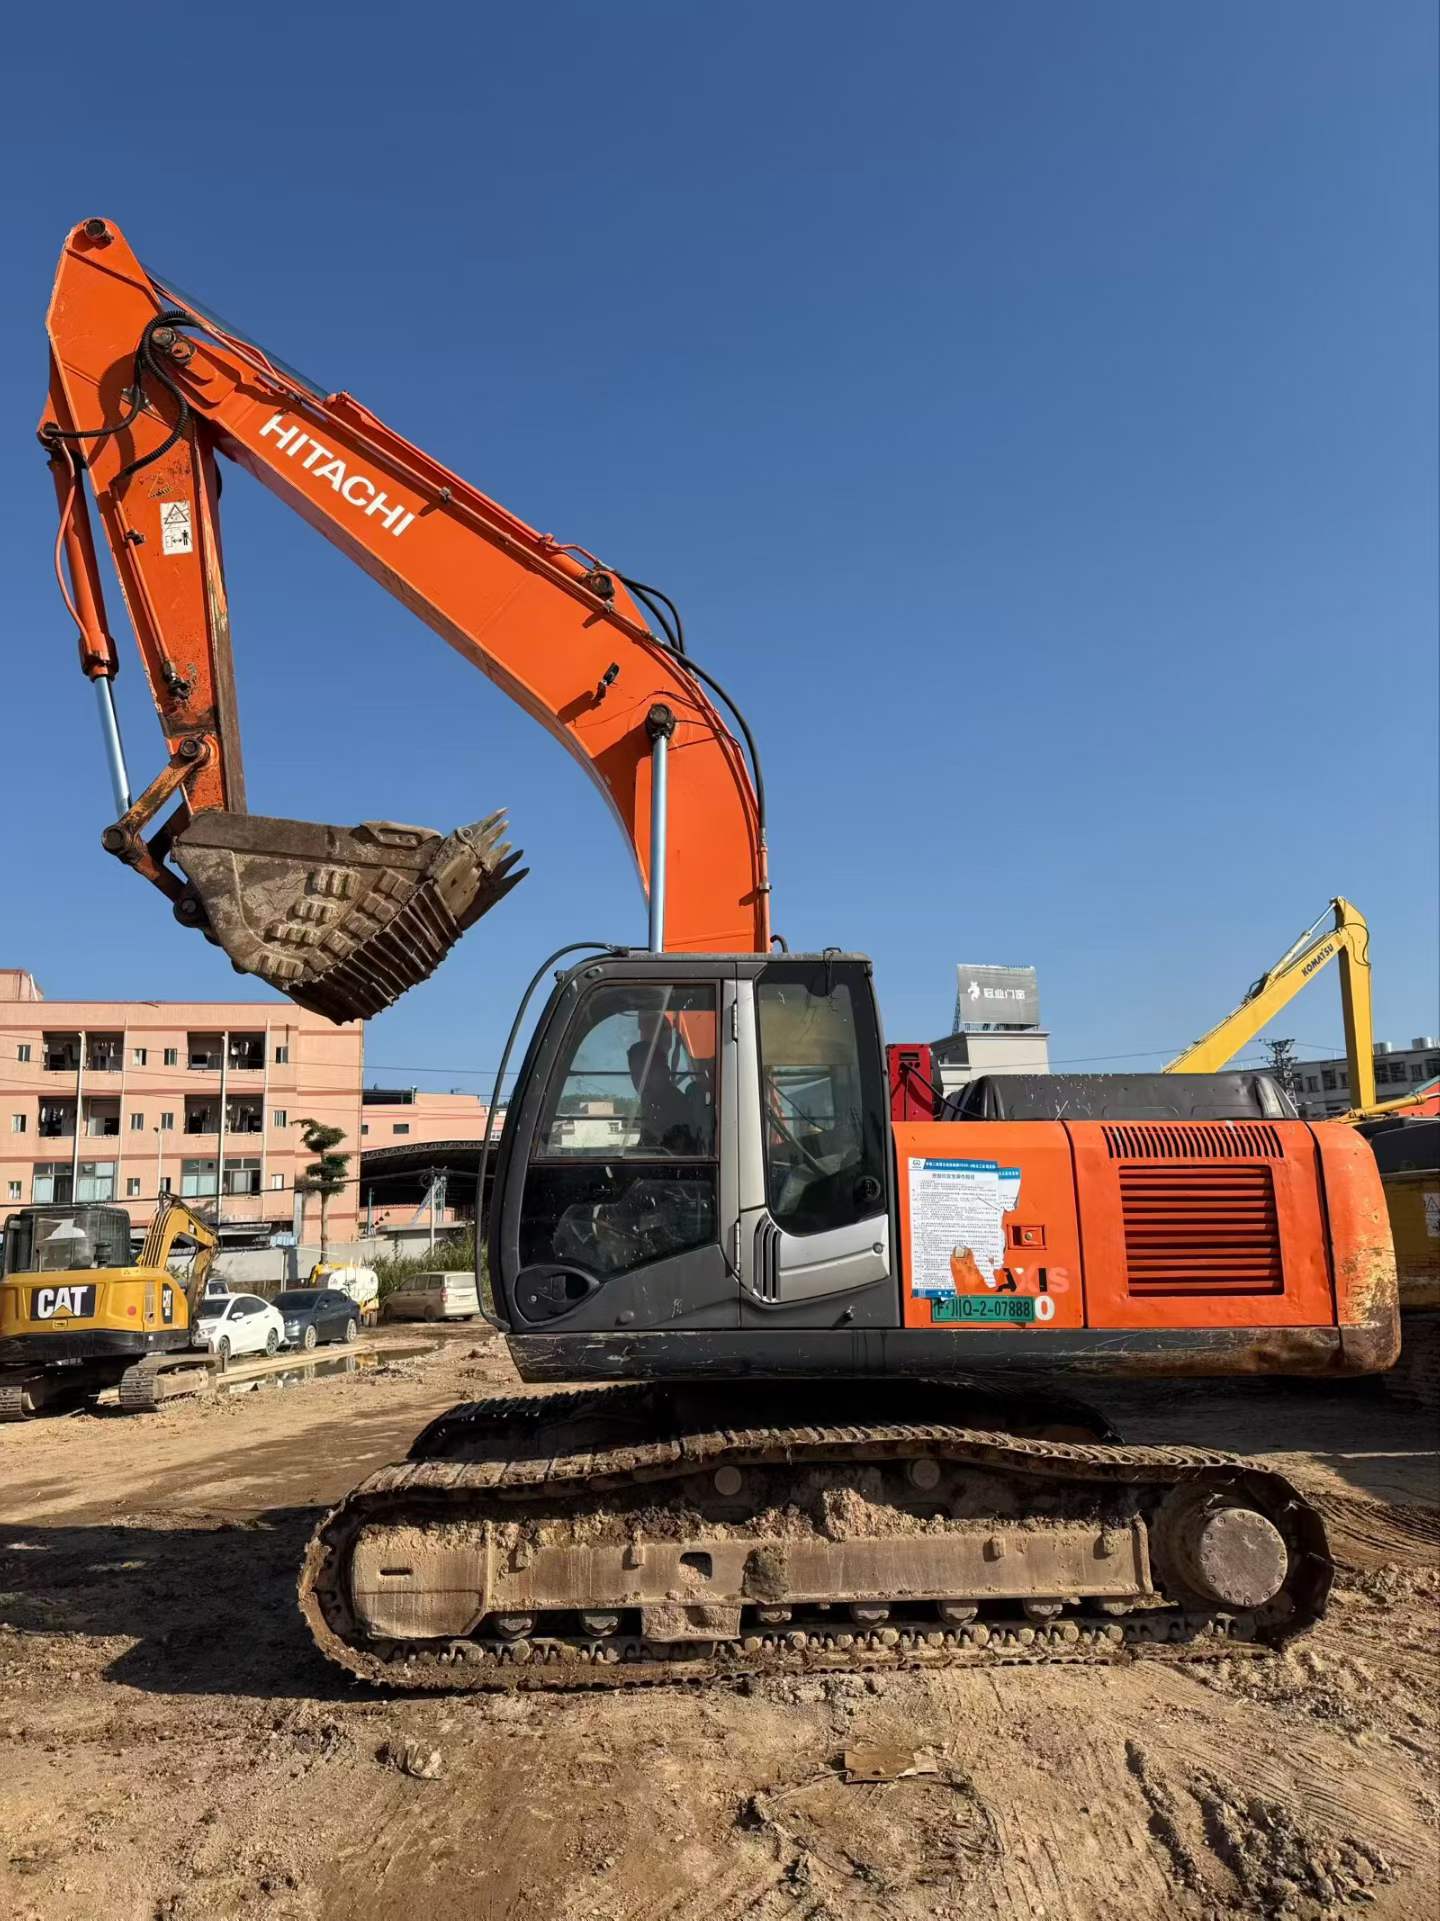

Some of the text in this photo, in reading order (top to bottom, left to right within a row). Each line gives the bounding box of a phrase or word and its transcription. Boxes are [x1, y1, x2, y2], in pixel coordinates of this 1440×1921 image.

[259, 414, 415, 536] HITACHI
[1302, 944, 1333, 976] KOMATSU
[37, 1286, 89, 1319] CAT
